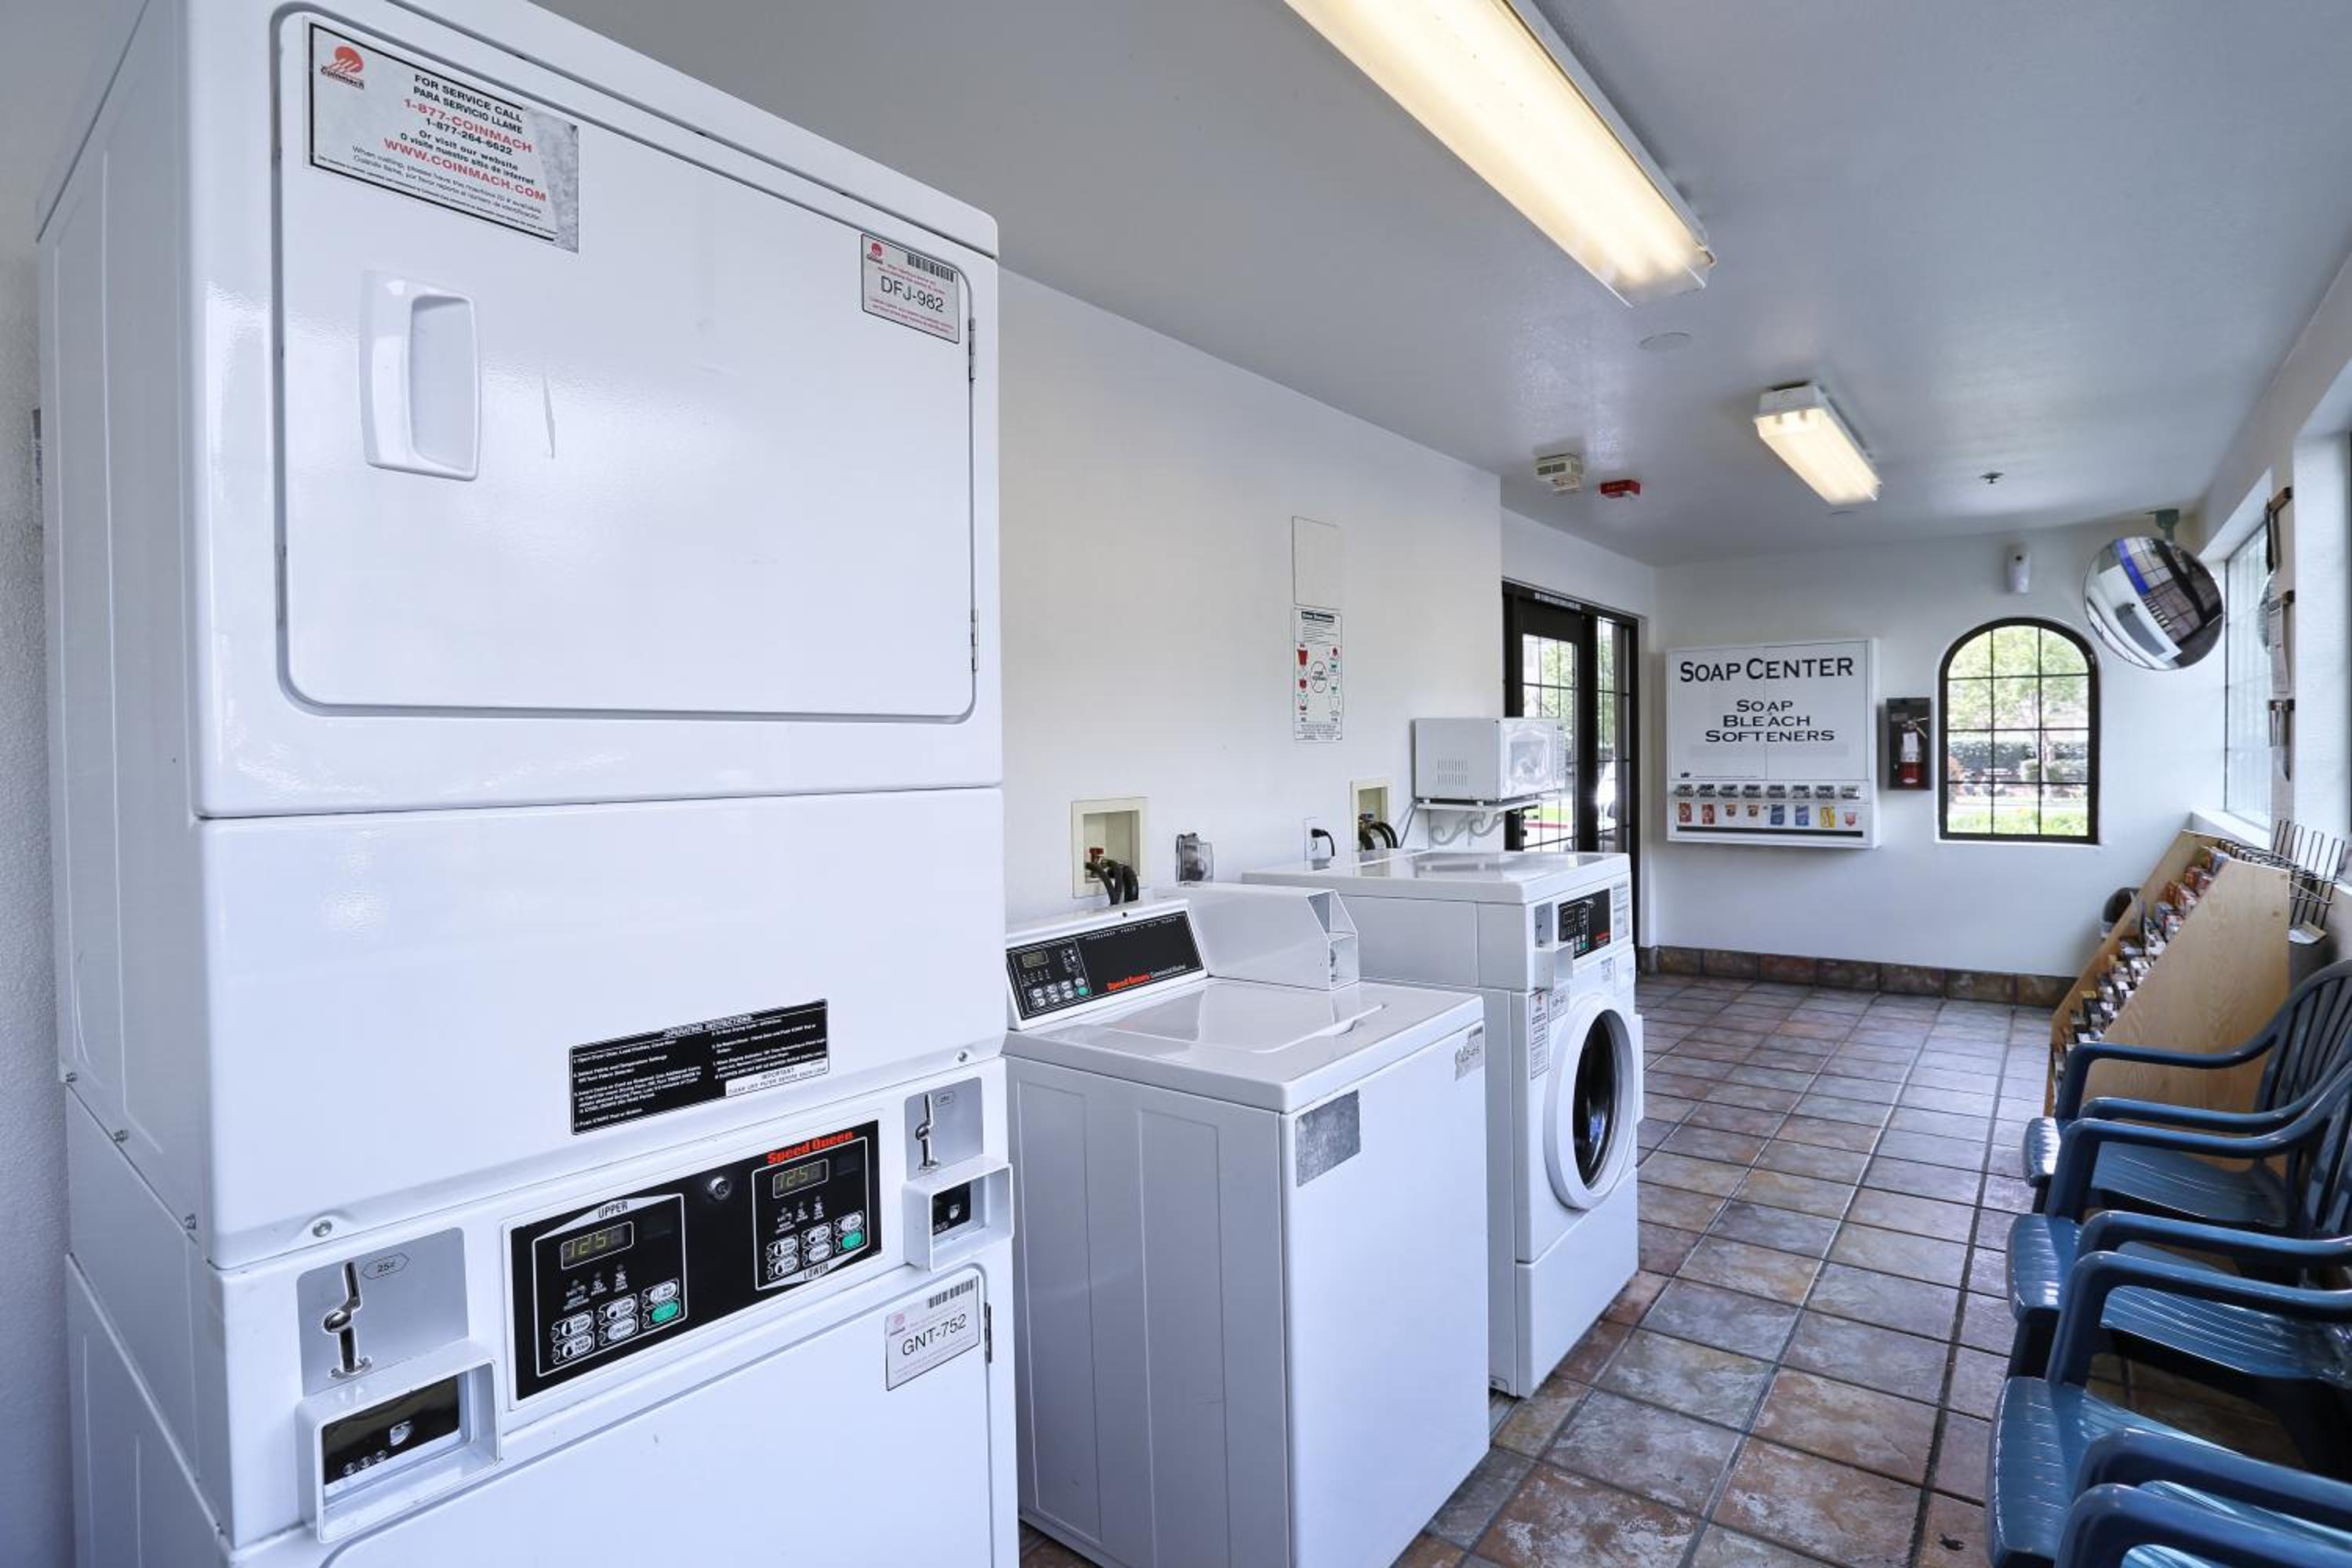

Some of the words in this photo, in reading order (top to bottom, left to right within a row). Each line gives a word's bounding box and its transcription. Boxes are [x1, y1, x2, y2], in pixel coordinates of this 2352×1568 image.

[413, 86, 441, 103] PARA
[443, 98, 488, 121] SERVICIO
[492, 118, 523, 134] LLAME
[415, 74, 439, 90] FOR
[442, 85, 492, 111] SERVICE
[495, 106, 523, 123] CALL
[404, 99, 532, 152] 1-877-COINMACH
[410, 137, 434, 149] visite
[436, 147, 470, 162] nuestro
[491, 164, 501, 173] de
[503, 169, 535, 186] internet
[419, 129, 432, 140] Or
[435, 136, 457, 149] visit
[460, 146, 477, 156] our
[481, 152, 518, 171] website
[384, 138, 546, 201] WWW.COINMACH.COM
[880, 275, 944, 313] DFJ-982
[1679, 661, 1741, 683] SOAP
[1746, 657, 1853, 680] CENTER
[1722, 715, 1810, 728] BLEACH
[1736, 699, 1794, 713] SOAP
[1705, 730, 1835, 742] SOFTENERS
[767, 1142, 810, 1164] Speed
[811, 1131, 854, 1151] Queen
[598, 1200, 628, 1219] UPPER
[803, 1263, 829, 1280] LOWER
[902, 1313, 967, 1356] GNT-752
